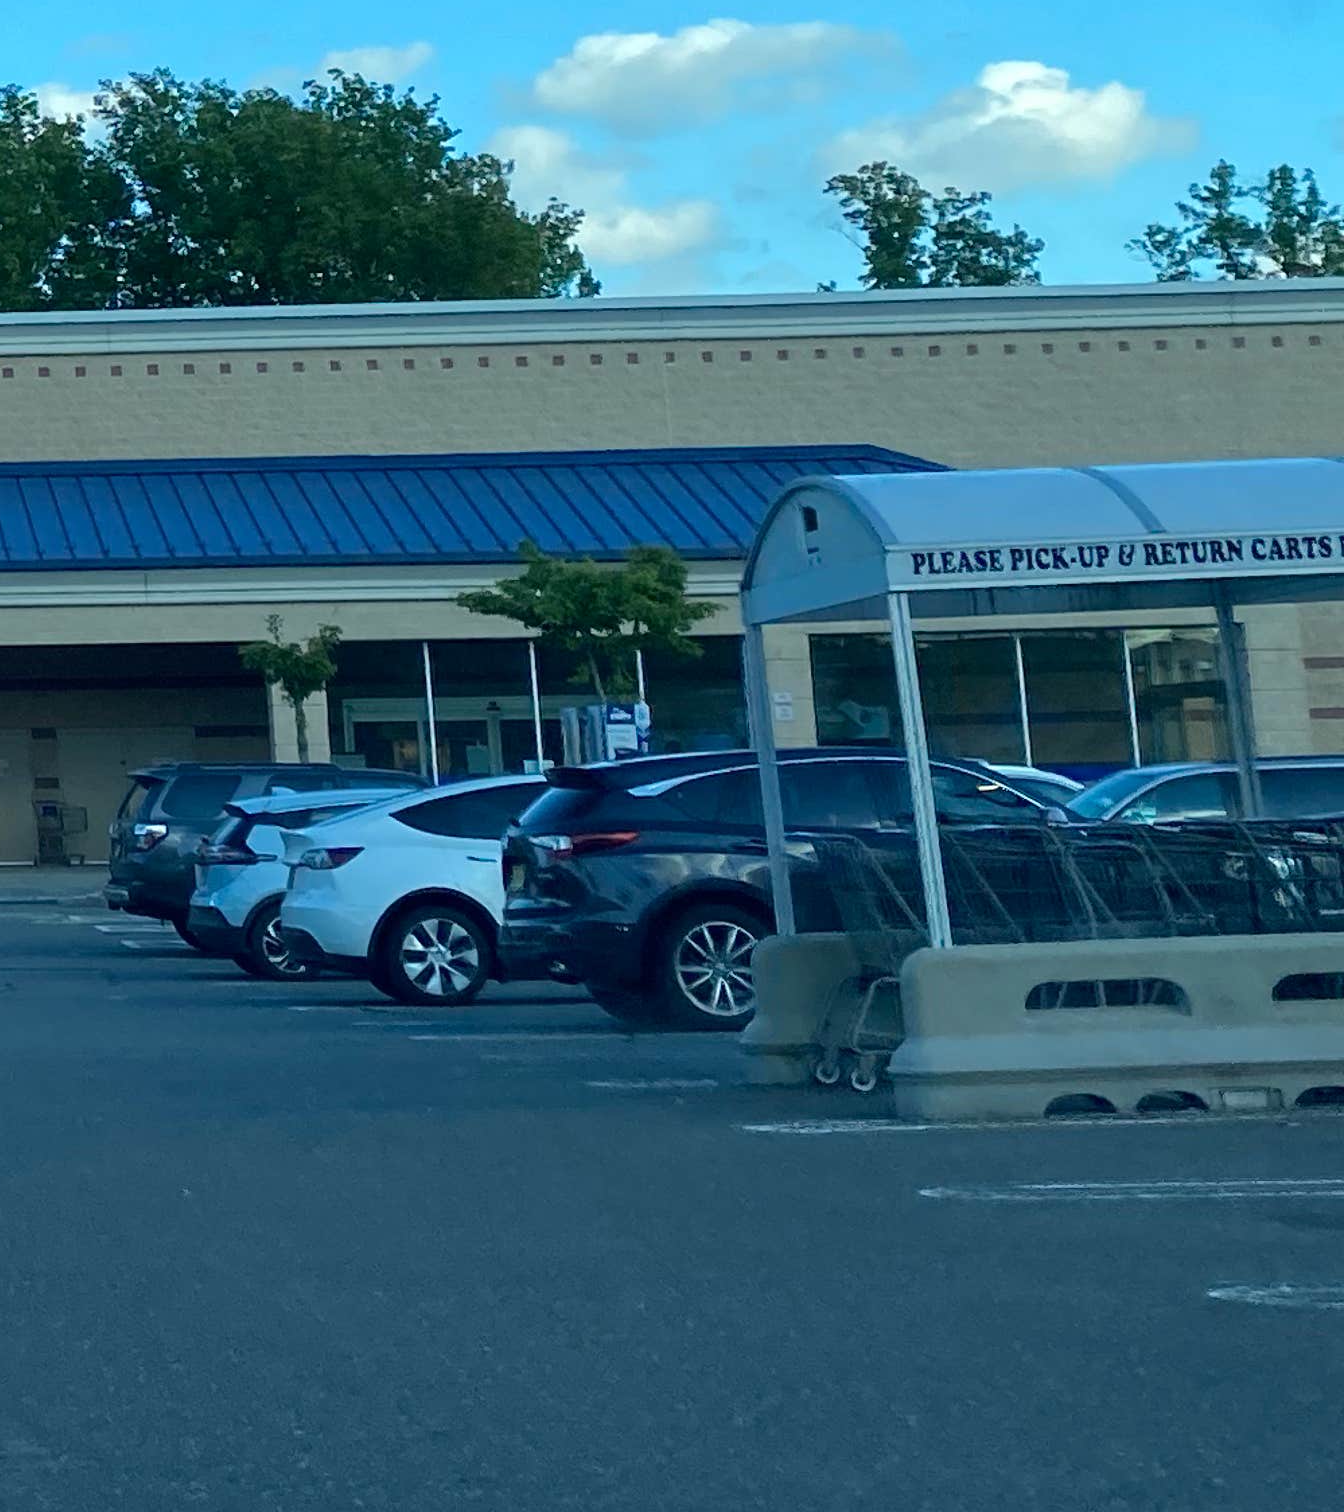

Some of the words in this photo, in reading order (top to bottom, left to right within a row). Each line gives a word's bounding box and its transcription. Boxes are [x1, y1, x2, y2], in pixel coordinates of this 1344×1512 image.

[912, 549, 1005, 576] PLEASE
[1010, 544, 1111, 571] PICK-UP
[1118, 544, 1135, 567] &
[1143, 539, 1244, 566] RETURN
[1250, 536, 1332, 560] CARTS
